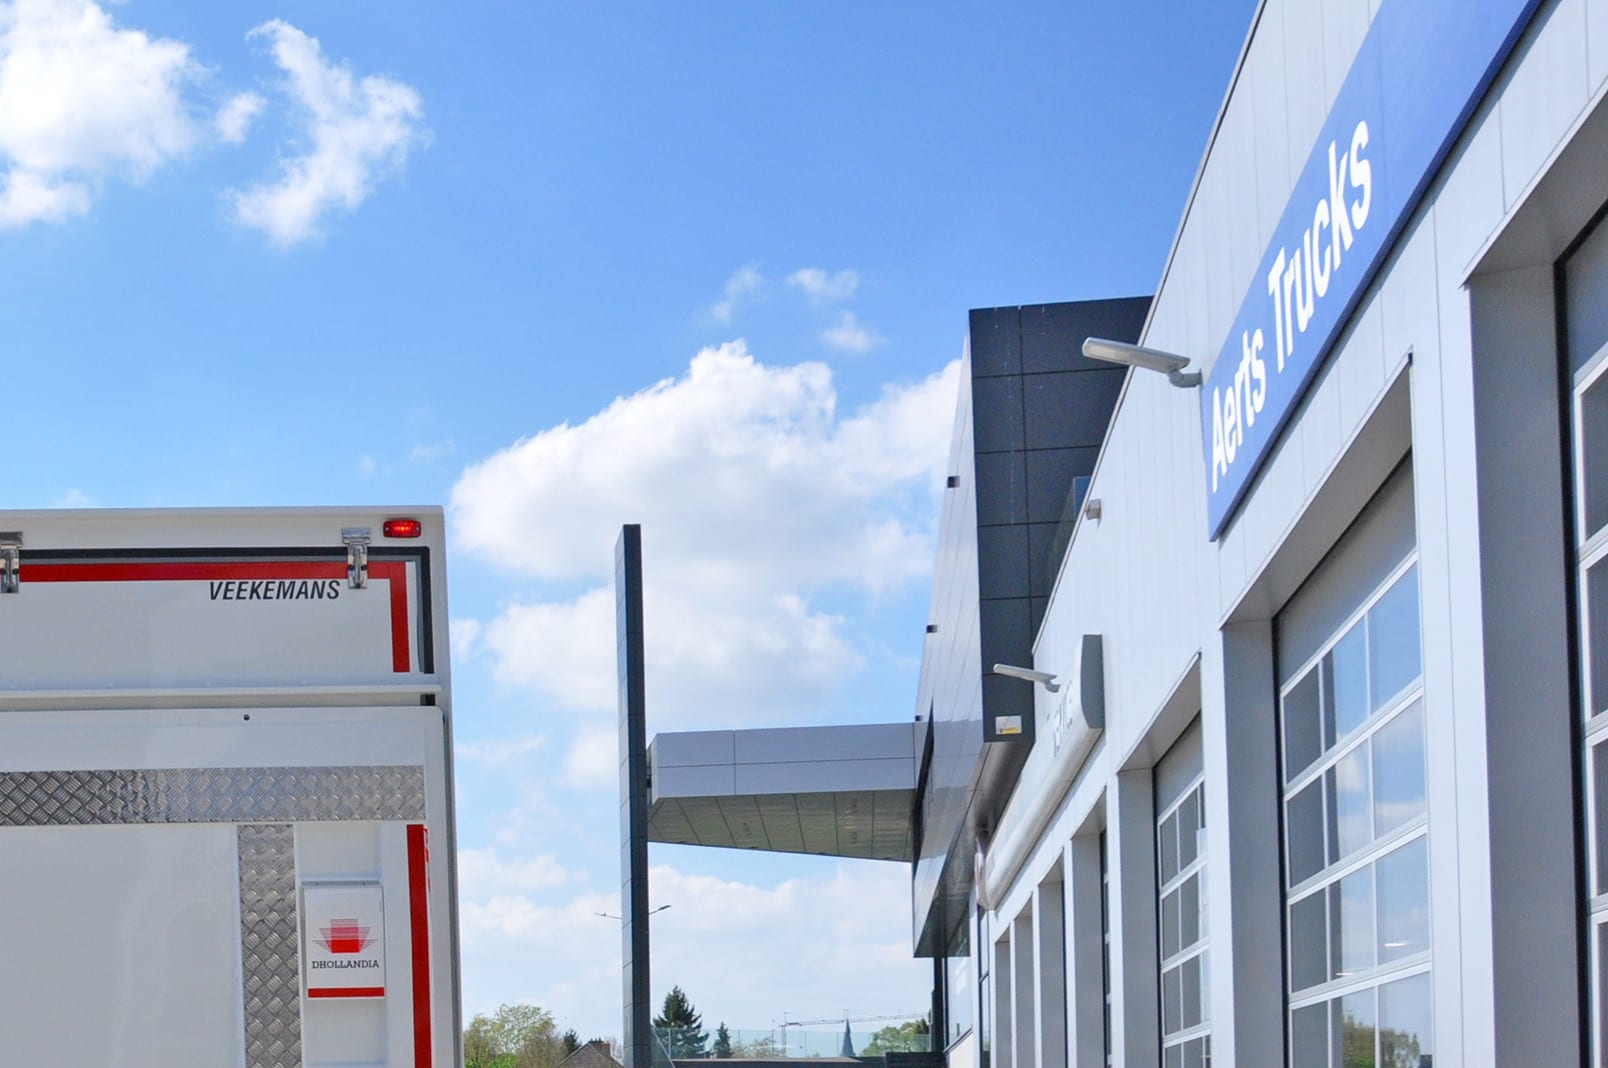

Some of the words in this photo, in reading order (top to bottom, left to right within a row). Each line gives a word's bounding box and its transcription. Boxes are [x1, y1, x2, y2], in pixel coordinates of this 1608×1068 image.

[1212, 328, 1266, 493] Aerts
[1268, 120, 1372, 373] Trucks
[210, 580, 341, 600] VEEKEMANS
[312, 960, 380, 969] DHOLLANDIA
